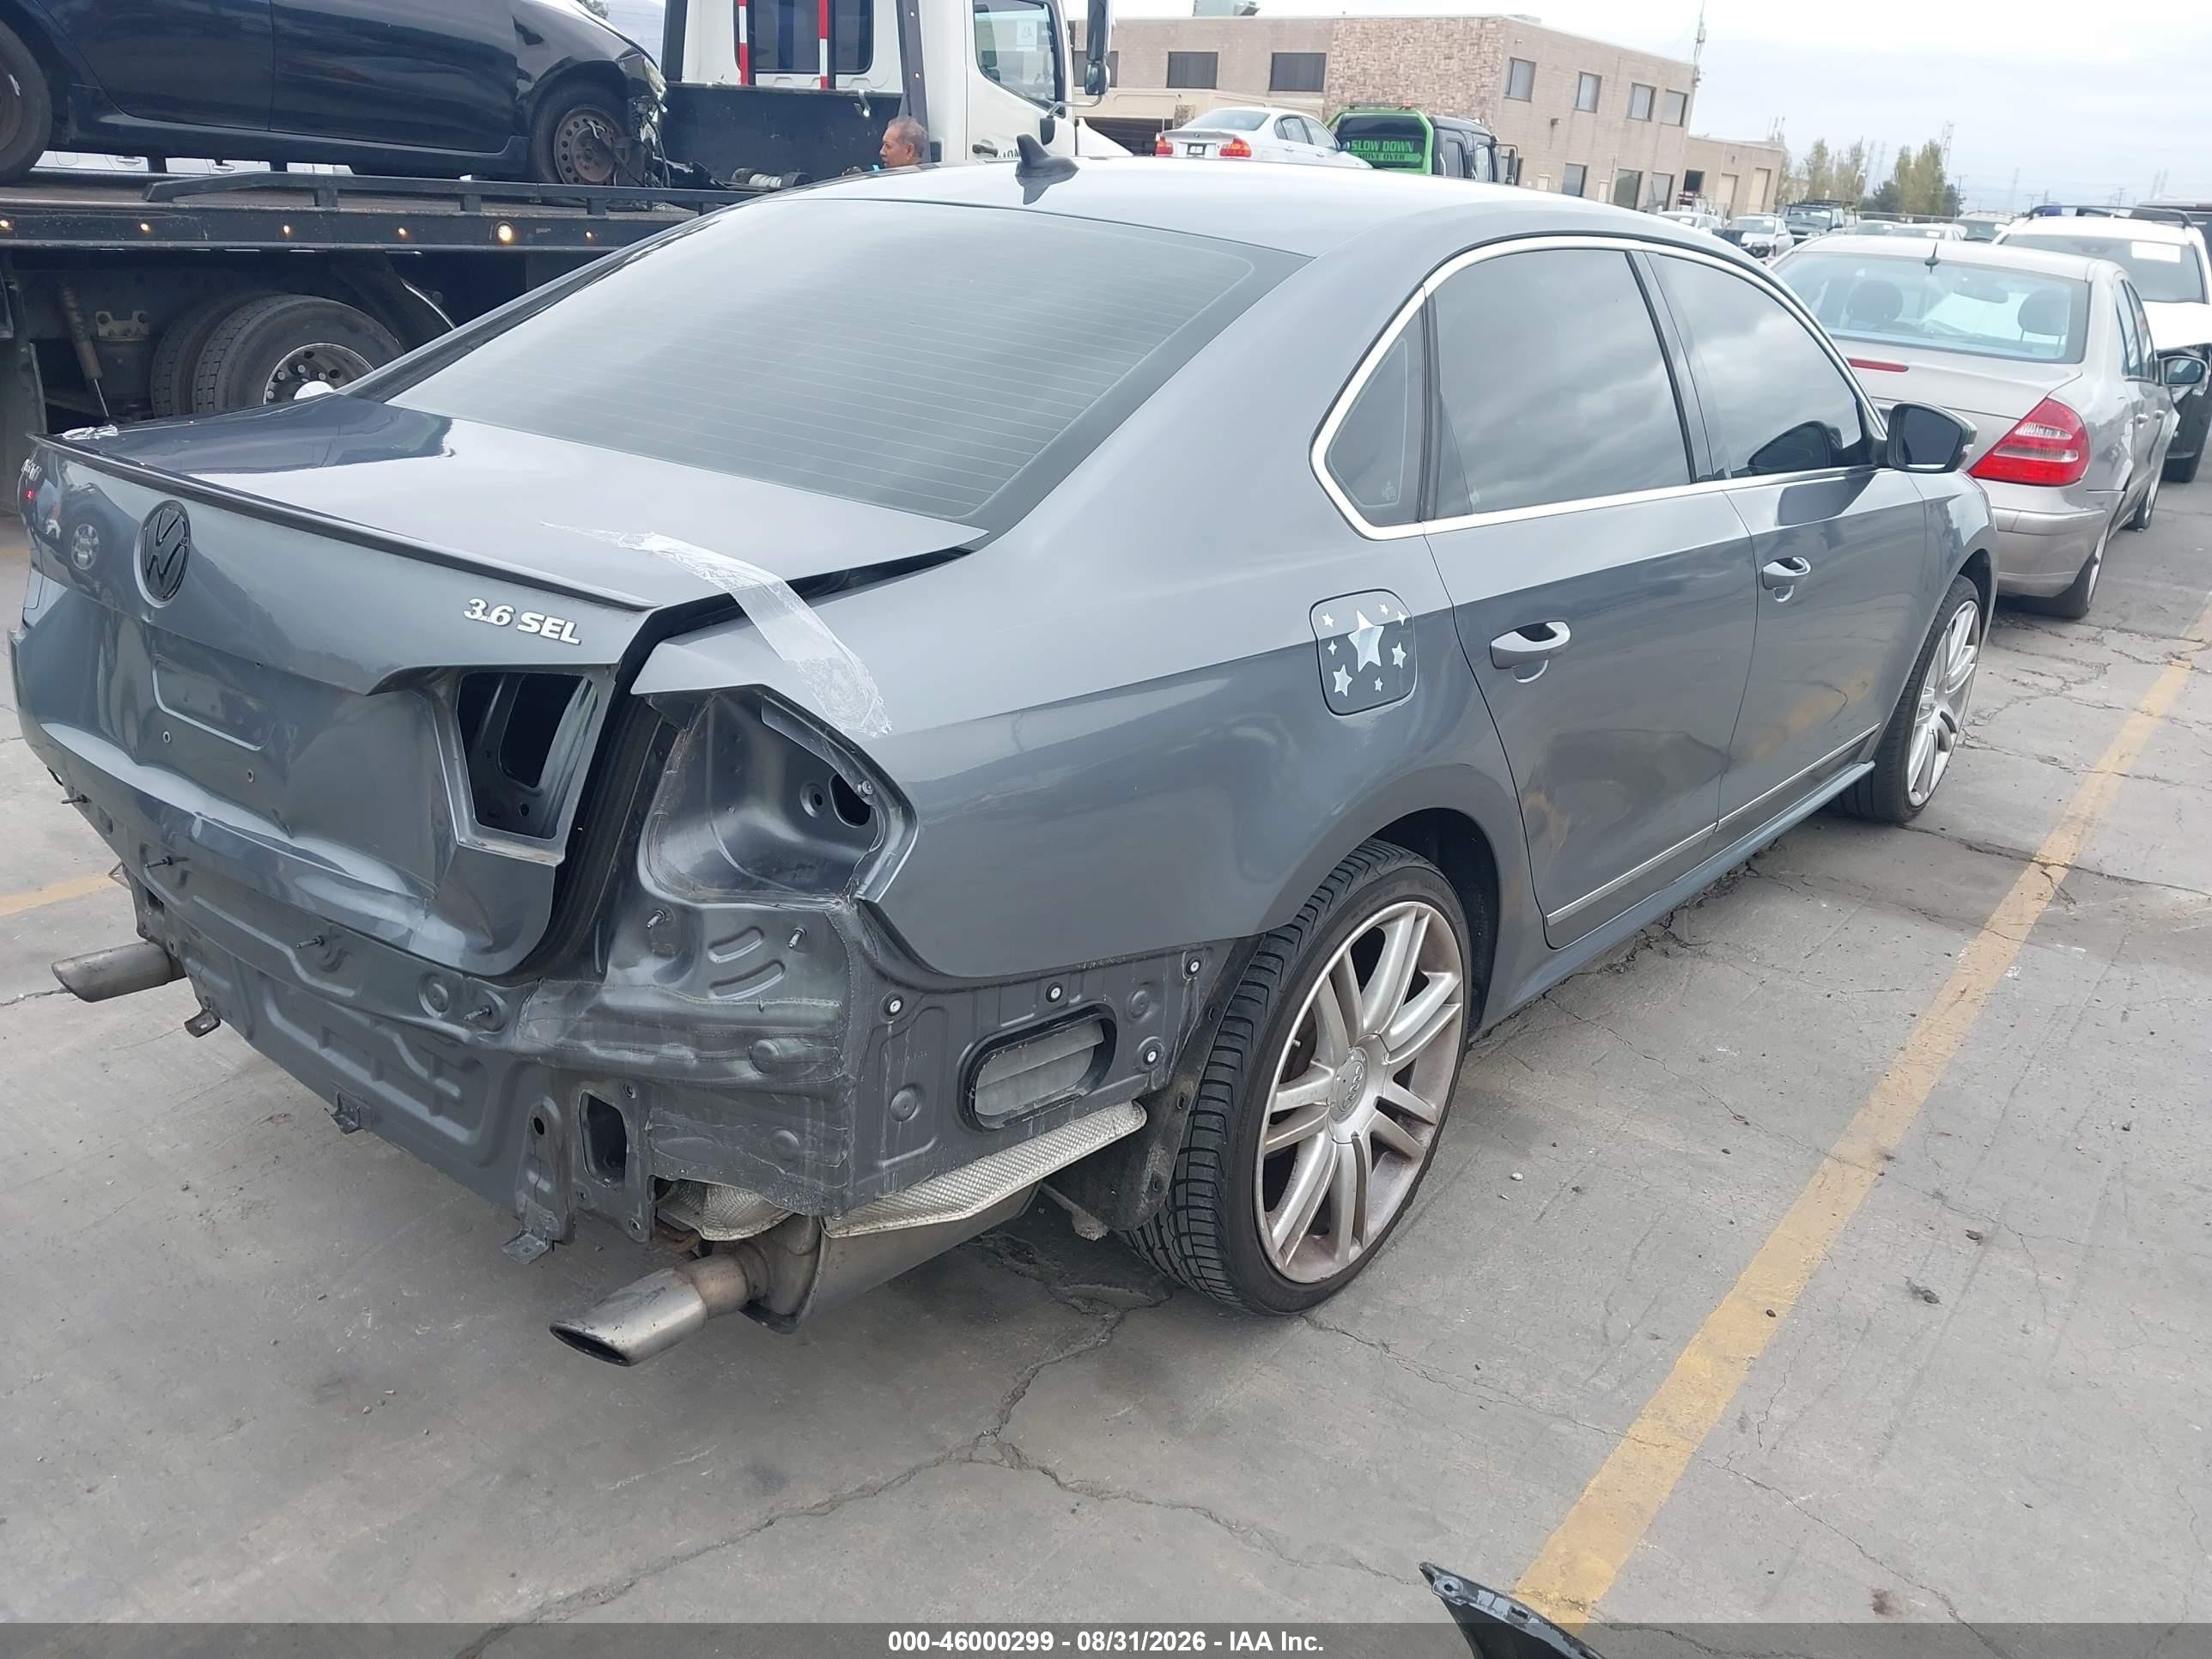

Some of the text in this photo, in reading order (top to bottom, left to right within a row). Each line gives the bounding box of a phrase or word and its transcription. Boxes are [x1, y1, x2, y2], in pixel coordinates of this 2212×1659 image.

[1351, 140, 1414, 152] SLOW DOWN
[1382, 152, 1406, 161] OVER
[464, 598, 581, 645] 3.6 SEL
